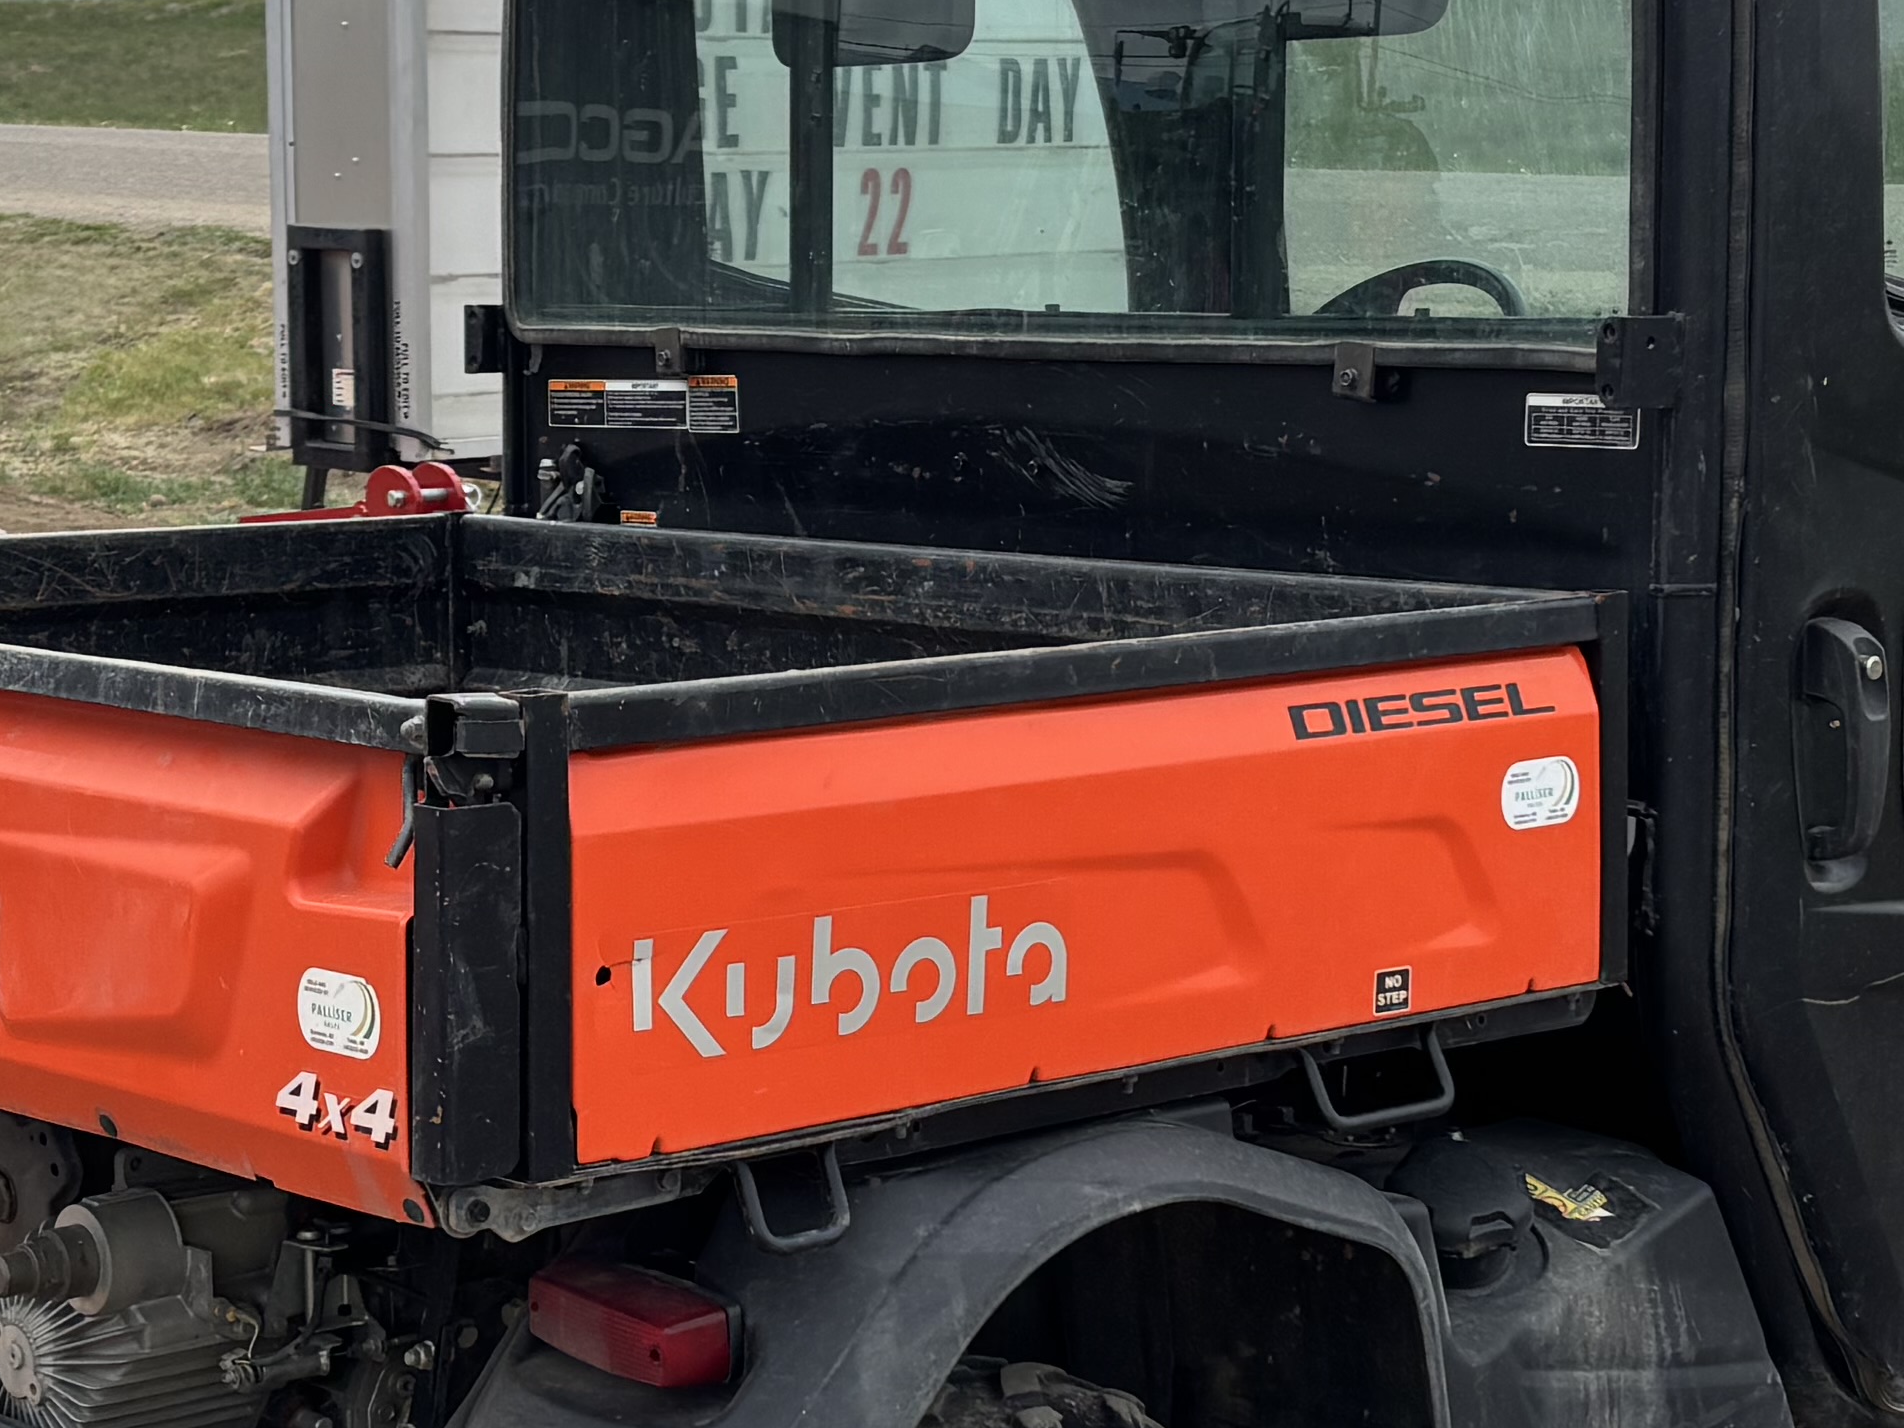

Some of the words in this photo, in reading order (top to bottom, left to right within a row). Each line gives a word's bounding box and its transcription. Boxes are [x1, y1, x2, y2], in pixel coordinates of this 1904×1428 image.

[997, 56, 1080, 145] DAY
[857, 167, 912, 257] 22
[1287, 683, 1556, 740] DIESEL
[632, 895, 1068, 1058] Kubota
[1377, 990, 1408, 1007] STEP
[1384, 974, 1403, 989] NO
[275, 1070, 398, 1152] 4x4
